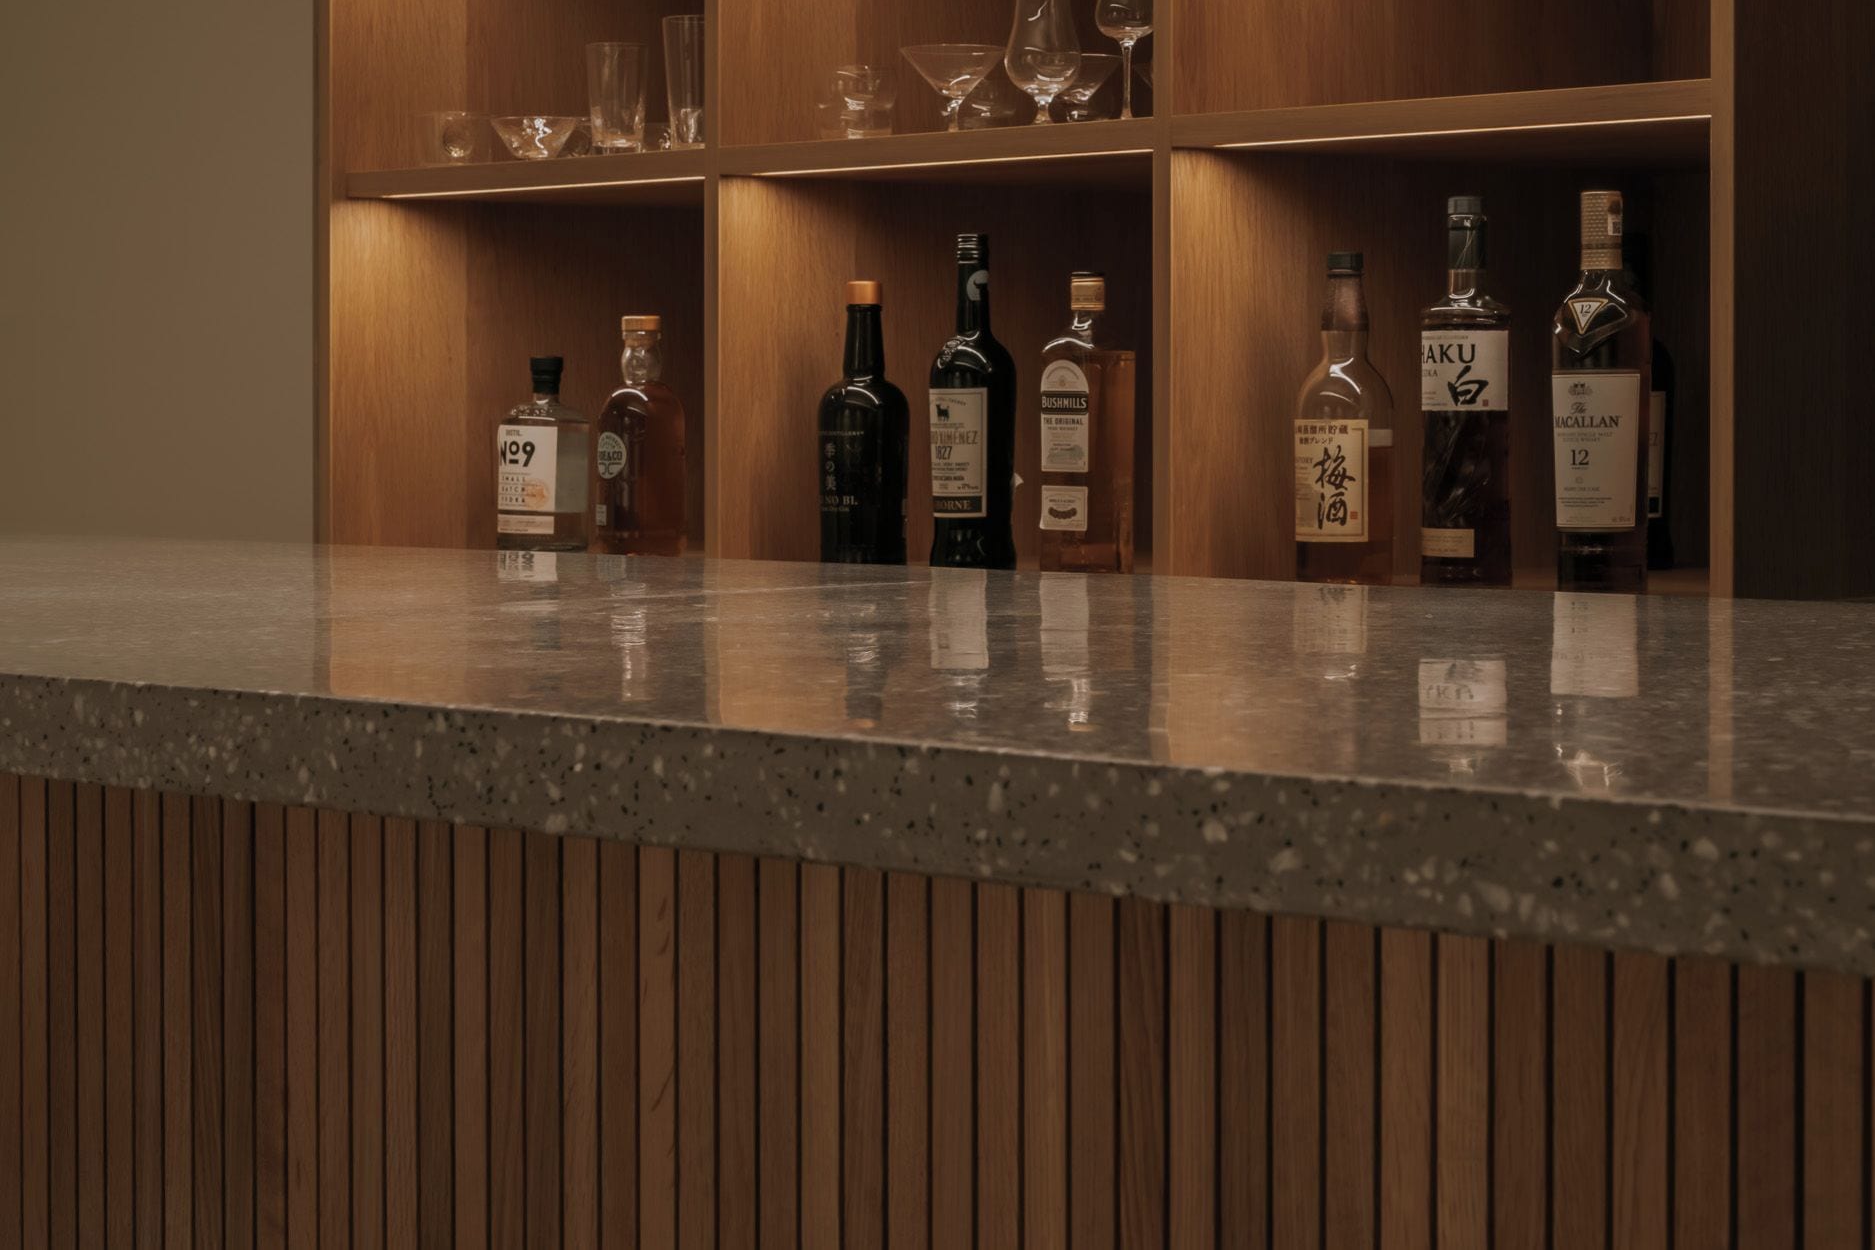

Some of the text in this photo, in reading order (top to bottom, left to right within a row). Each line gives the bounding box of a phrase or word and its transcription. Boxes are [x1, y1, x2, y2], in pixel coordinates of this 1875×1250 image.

[1580, 304, 1591, 314] 12
[1447, 365, 1489, 407] 白
[1042, 396, 1087, 409] BUSHMILLS
[1570, 449, 1590, 466] 12
[1312, 444, 1356, 530] 梅酒
